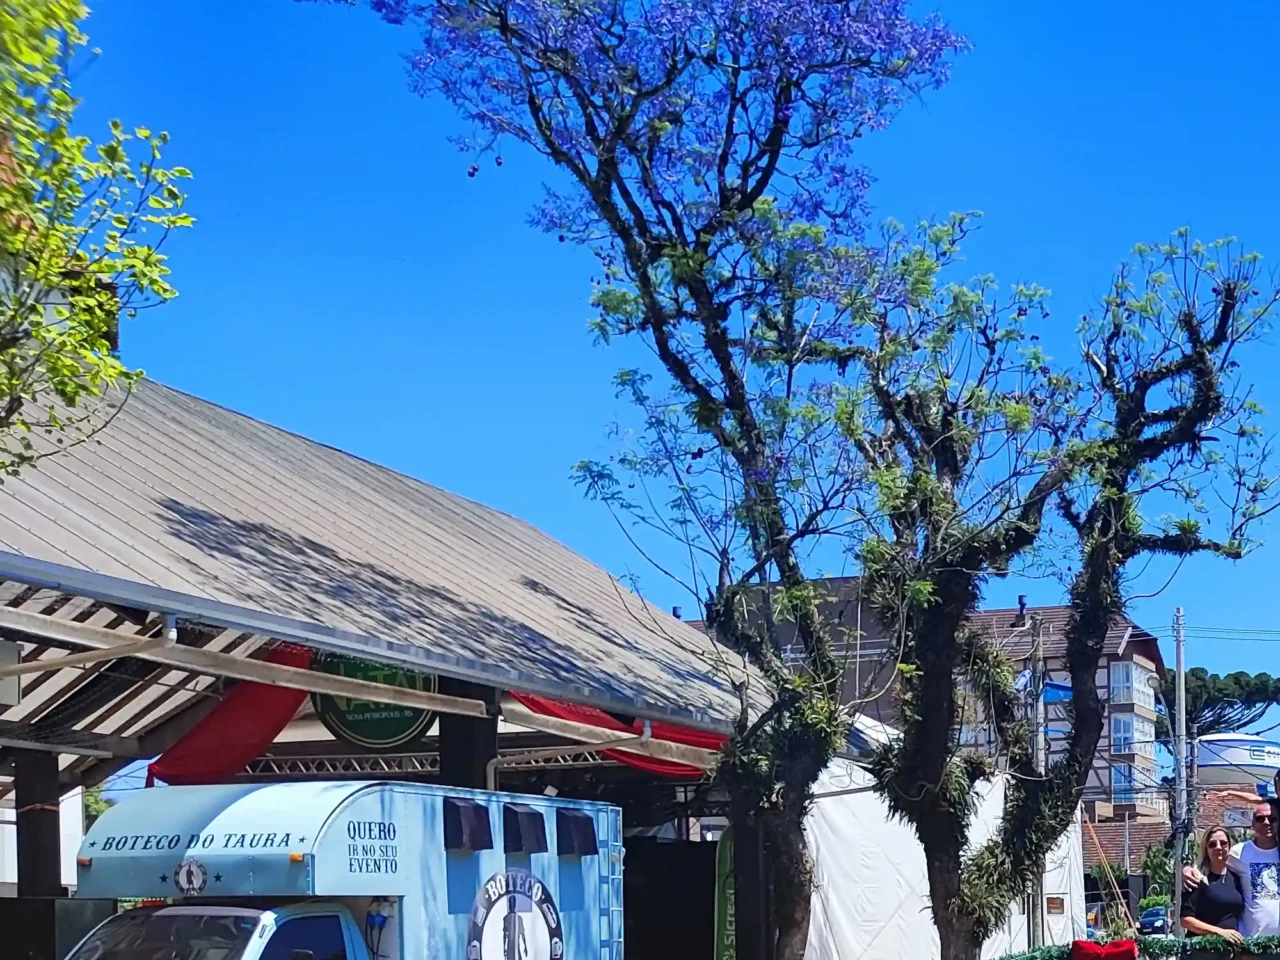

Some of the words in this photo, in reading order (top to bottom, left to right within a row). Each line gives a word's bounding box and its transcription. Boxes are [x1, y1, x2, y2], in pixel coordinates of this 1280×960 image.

[347, 820, 397, 842] QUERO
[101, 835, 180, 850] BOTECO
[185, 834, 214, 849] DO
[223, 833, 291, 848] TAURA
[348, 844, 359, 857] IR
[362, 844, 376, 857] NO
[379, 845, 397, 858] SEU
[349, 858, 398, 874] EVENTO
[485, 871, 543, 902] BOTECO
